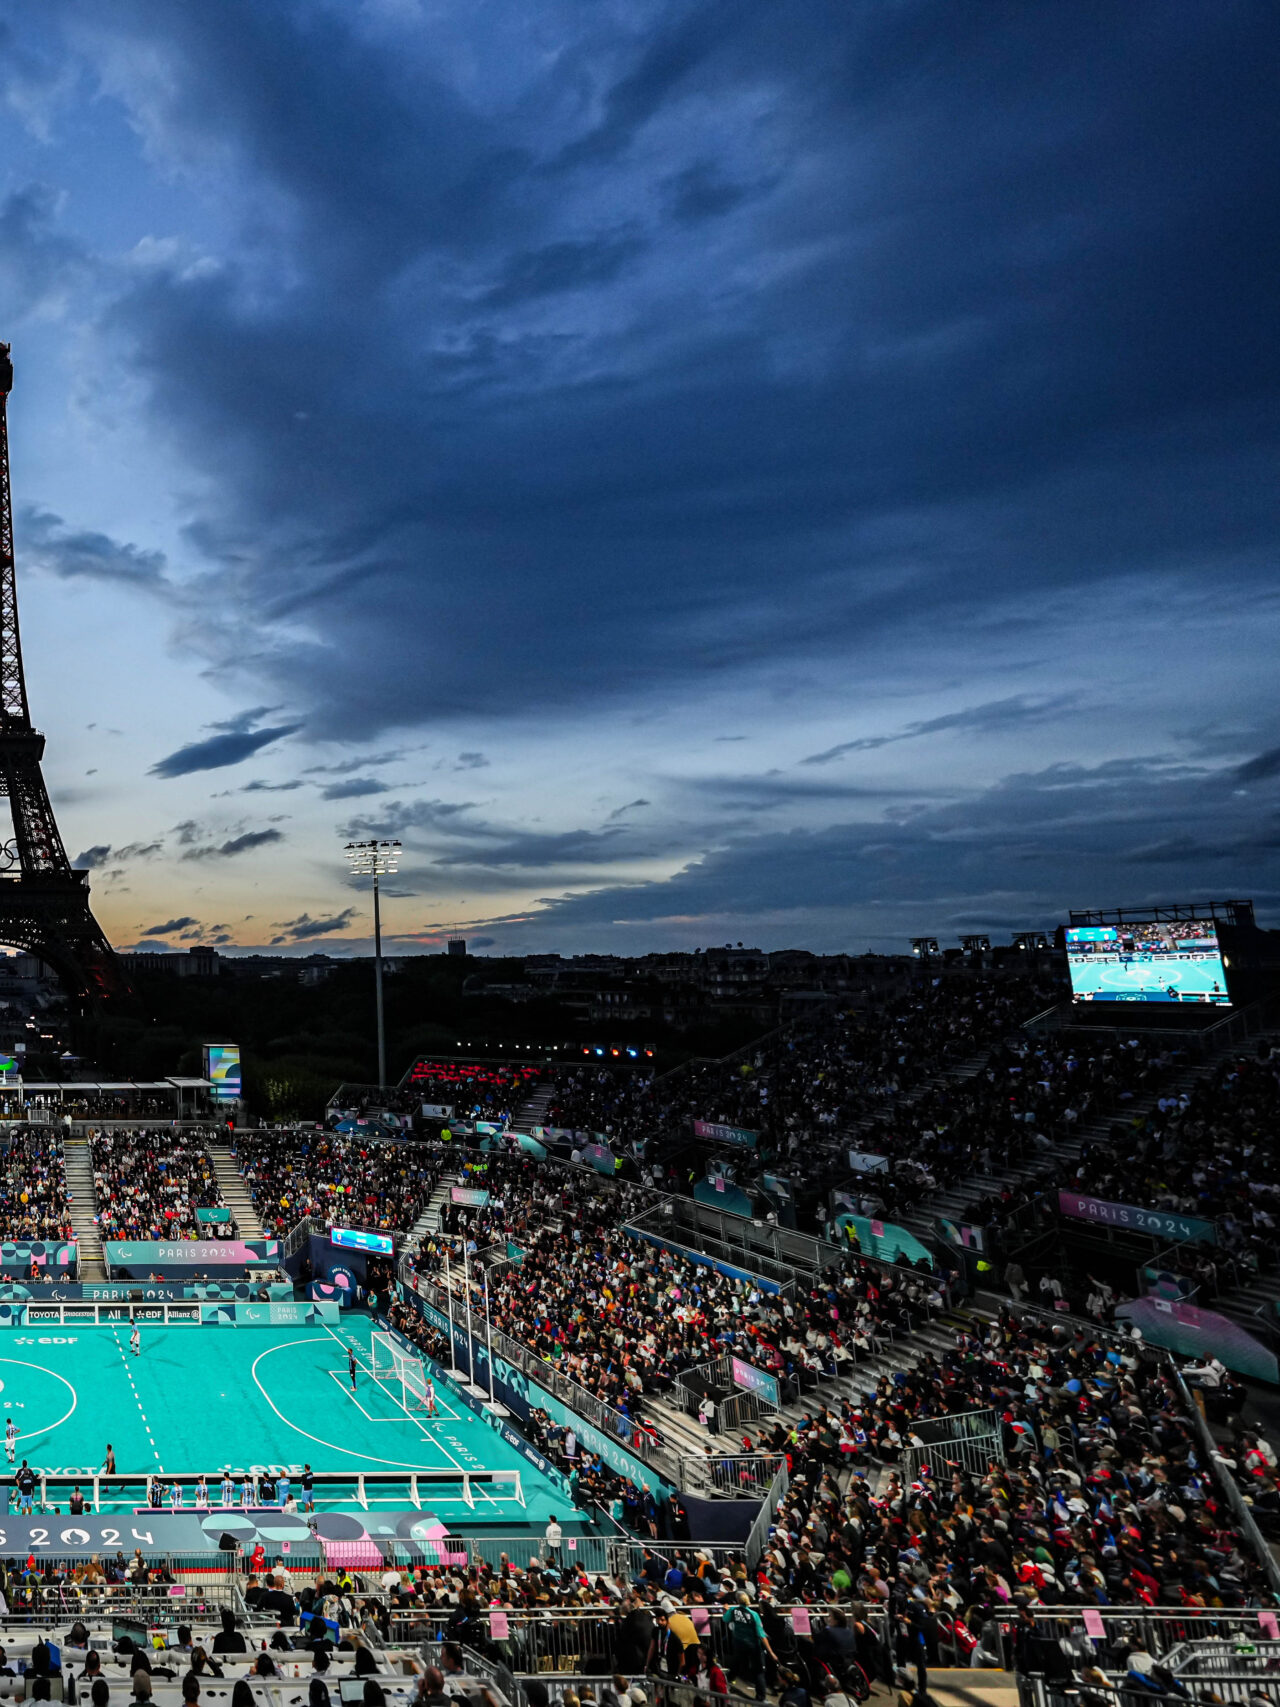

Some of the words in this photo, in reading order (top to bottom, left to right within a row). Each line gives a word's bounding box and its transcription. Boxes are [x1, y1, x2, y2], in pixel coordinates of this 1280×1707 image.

[701, 1125, 724, 1137] PARIS
[1078, 1201, 1129, 1222] PARIS
[1136, 1213, 1190, 1235] 2024
[159, 1248, 196, 1258] PARIS
[201, 1248, 235, 1258] 2024
[142, 1290, 173, 1299] 024
[108, 1310, 121, 1320] All
[428, 1311, 449, 1333] PARIS
[453, 1330, 469, 1349] 024
[443, 1435, 478, 1462] PARIS
[29, 1528, 153, 1546] 2024
